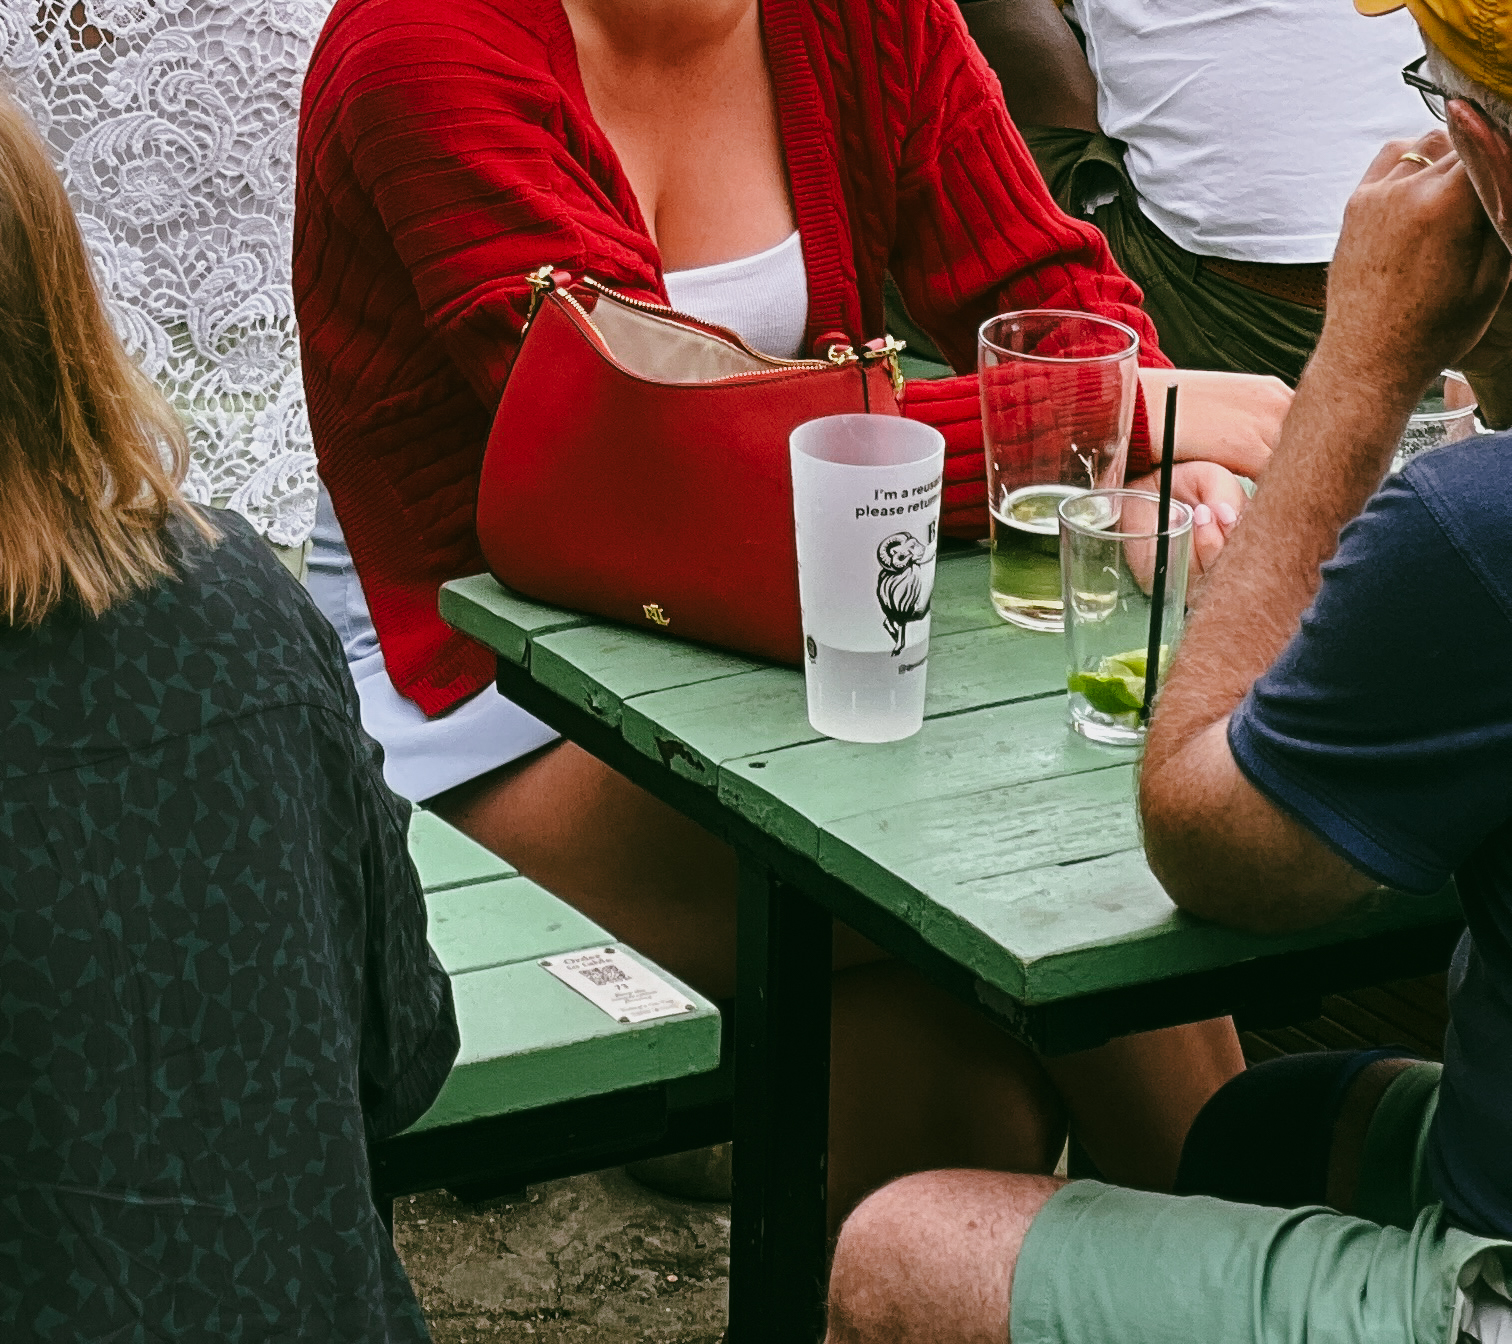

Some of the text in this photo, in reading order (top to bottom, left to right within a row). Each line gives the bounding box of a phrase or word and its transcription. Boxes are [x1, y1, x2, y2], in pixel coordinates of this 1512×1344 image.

[874, 488, 898, 501] I'm
[901, 489, 909, 499] a
[855, 504, 905, 520] please
